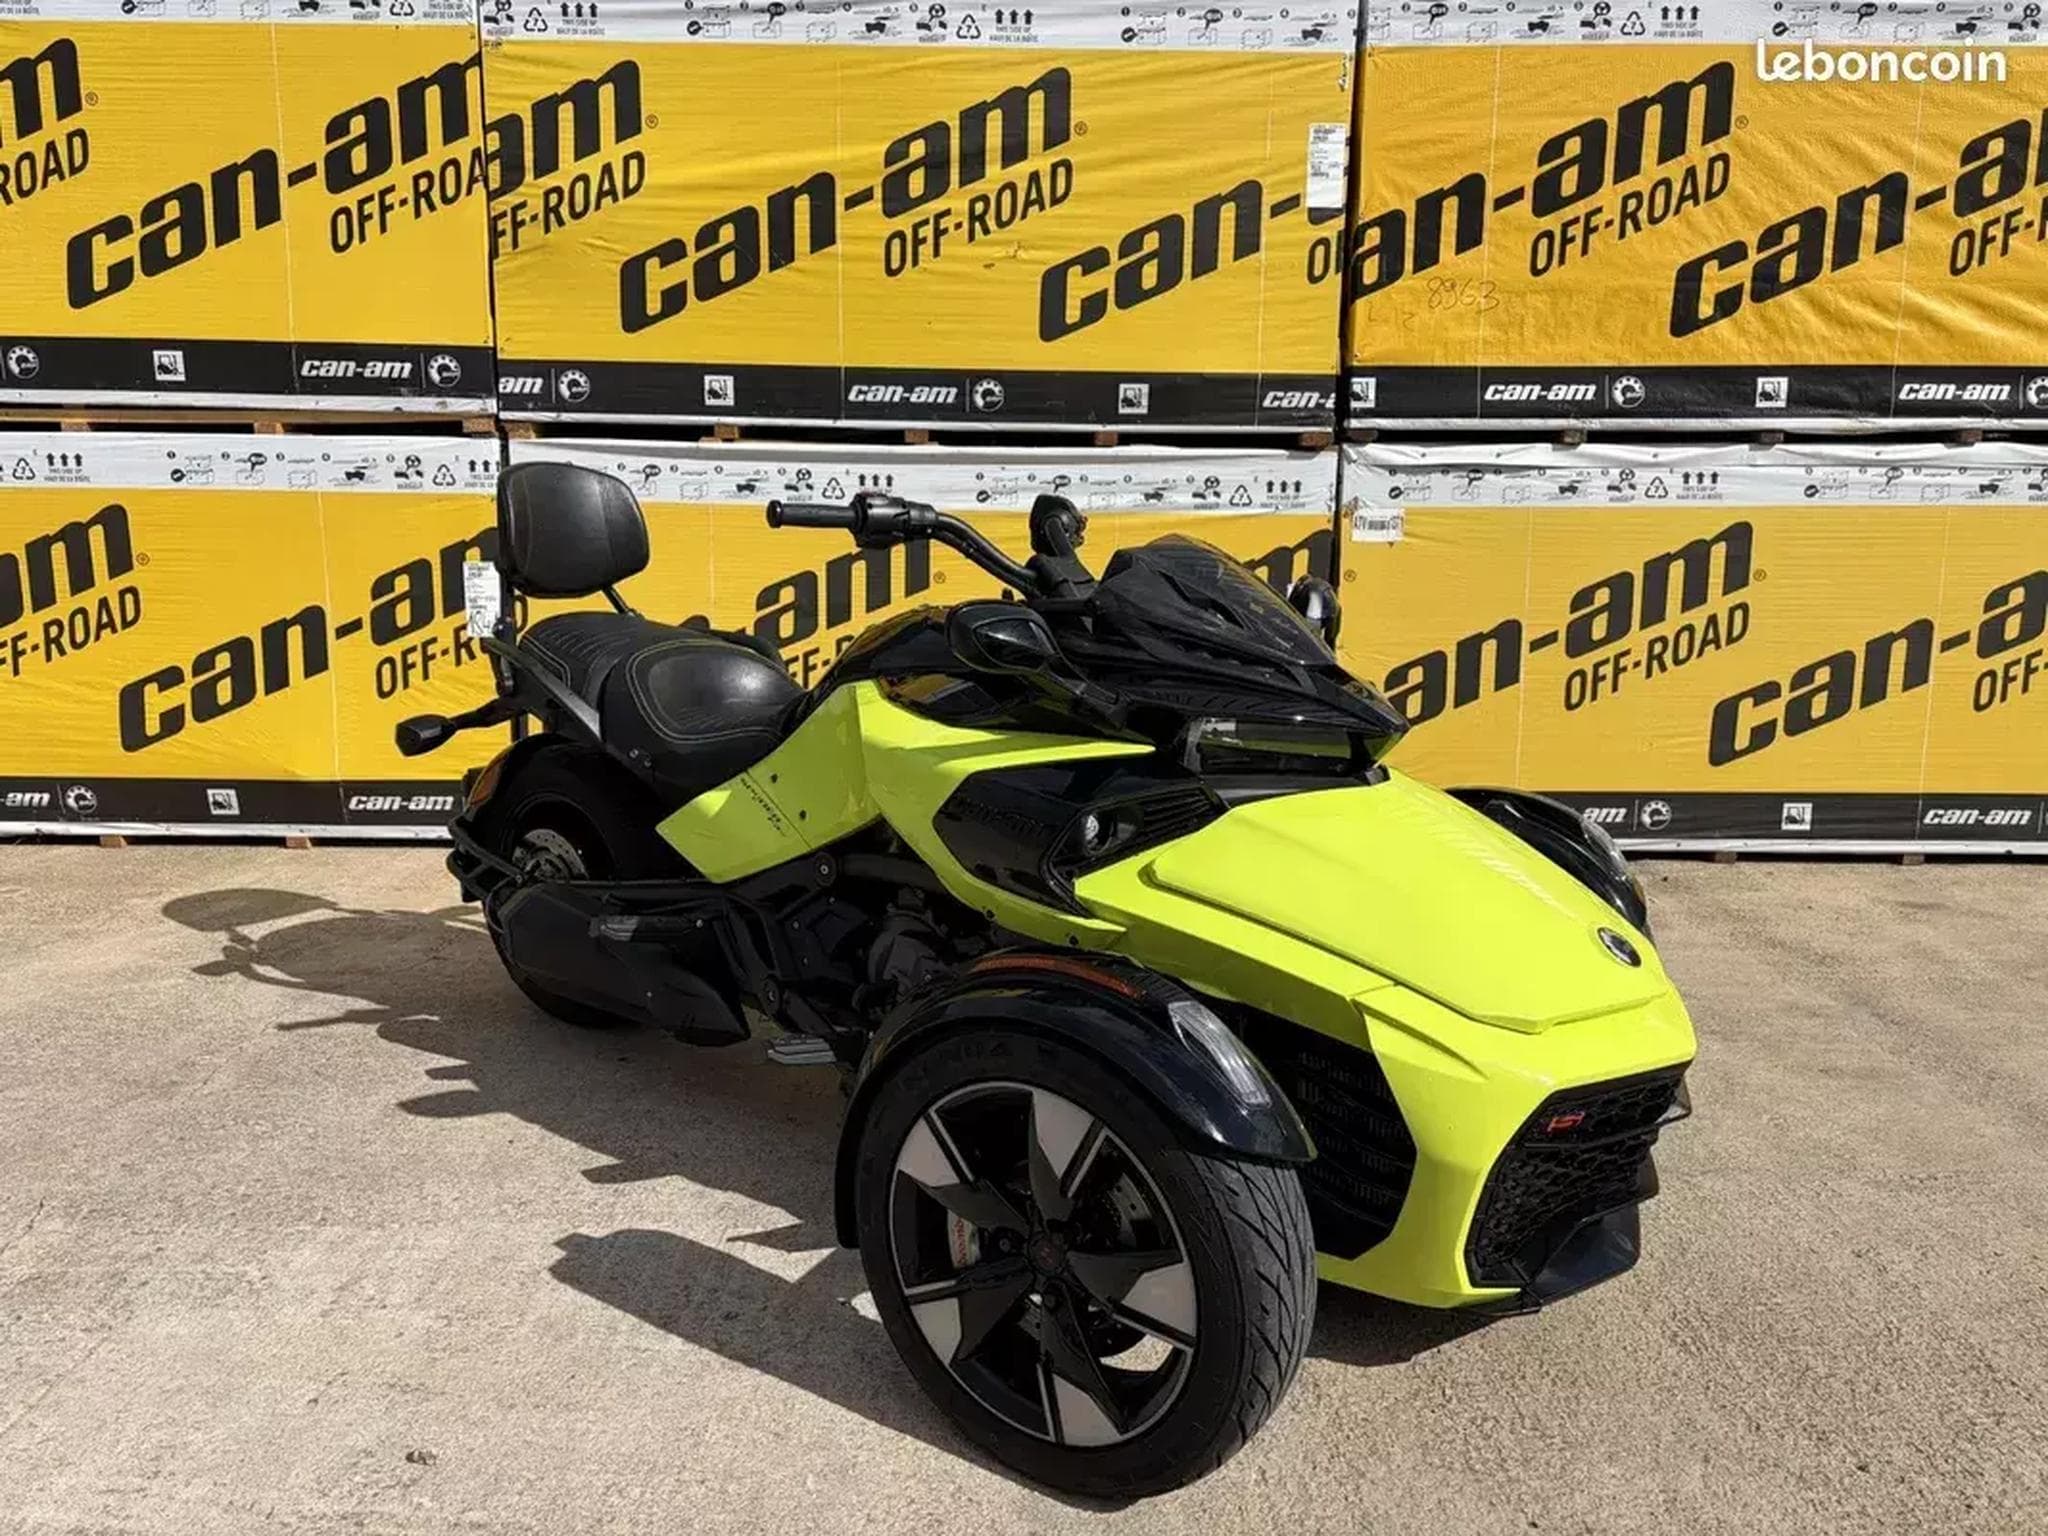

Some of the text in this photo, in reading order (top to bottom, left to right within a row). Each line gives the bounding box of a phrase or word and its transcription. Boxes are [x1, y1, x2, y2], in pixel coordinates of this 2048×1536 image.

[620, 66, 1071, 334] can-am
[884, 157, 1073, 278] OFF-ROAD
[1530, 152, 1731, 277] OFF-ROAD
[1669, 107, 2048, 338] can-a
[1039, 178, 1345, 343] can-
[1427, 276, 1499, 314] 8963
[301, 356, 413, 379] can-am
[847, 383, 958, 405] can-am
[1483, 380, 1597, 401] can-am
[1899, 381, 2011, 401] can-am
[1564, 602, 1750, 711] OFF-ROAD
[350, 793, 454, 812] can-am
[1922, 808, 2033, 825] can-am
